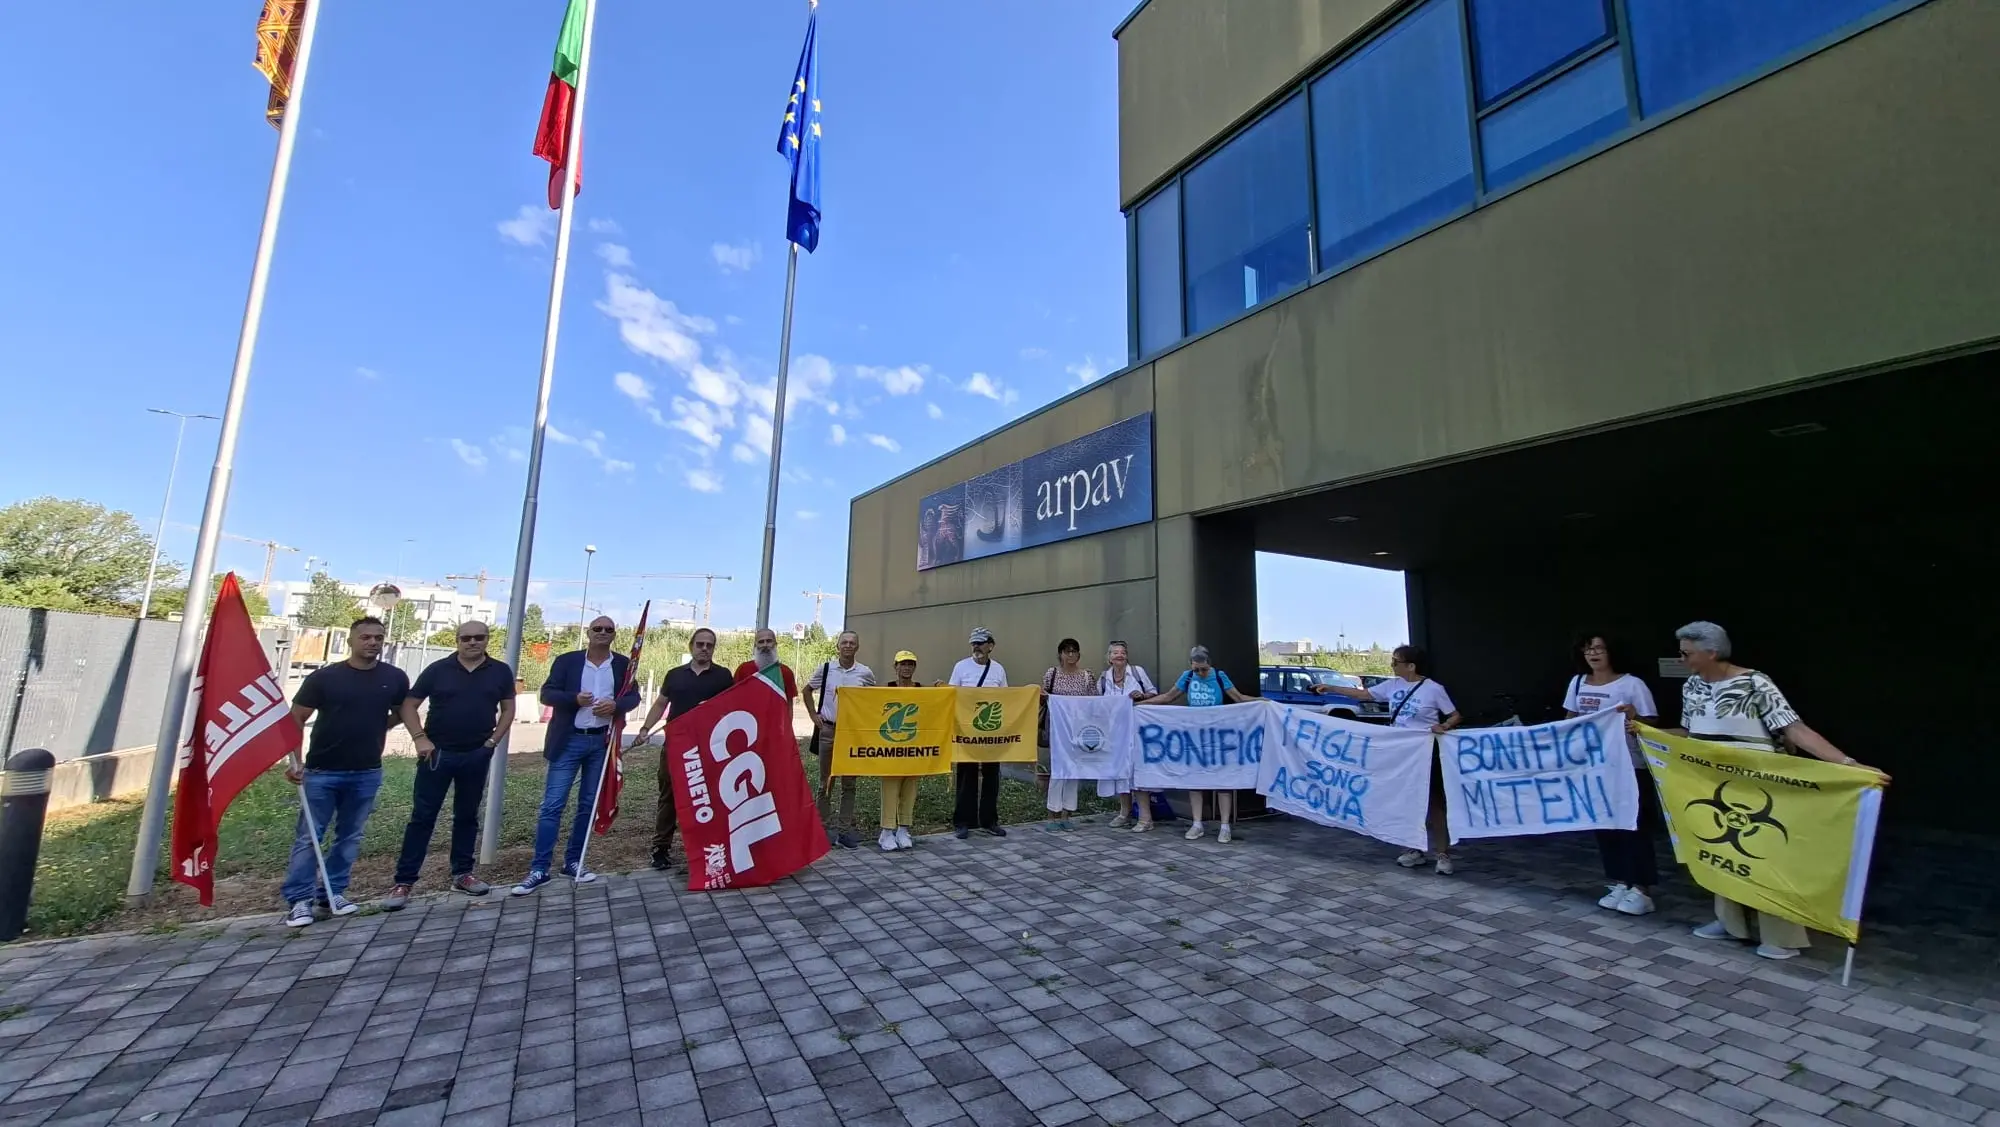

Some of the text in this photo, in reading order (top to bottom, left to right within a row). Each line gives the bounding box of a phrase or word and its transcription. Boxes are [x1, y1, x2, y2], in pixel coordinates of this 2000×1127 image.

[1037, 454, 1133, 531] arpav
[849, 746, 940, 758] LEGAMBIENTE
[951, 735, 1022, 745] LEGAMBIENTE
[1295, 719, 1370, 768] FIGLI
[1458, 722, 1605, 775] BONIFICA
[682, 745, 714, 824] VENETO
[709, 710, 782, 874] CGIL
[1269, 767, 1365, 827] ACQUA
[1306, 761, 1369, 796] SONO
[1680, 753, 1820, 791] ZONA CONTAMINATA
[1461, 774, 1613, 828] MITENI
[1698, 849, 1751, 877] PFAS
